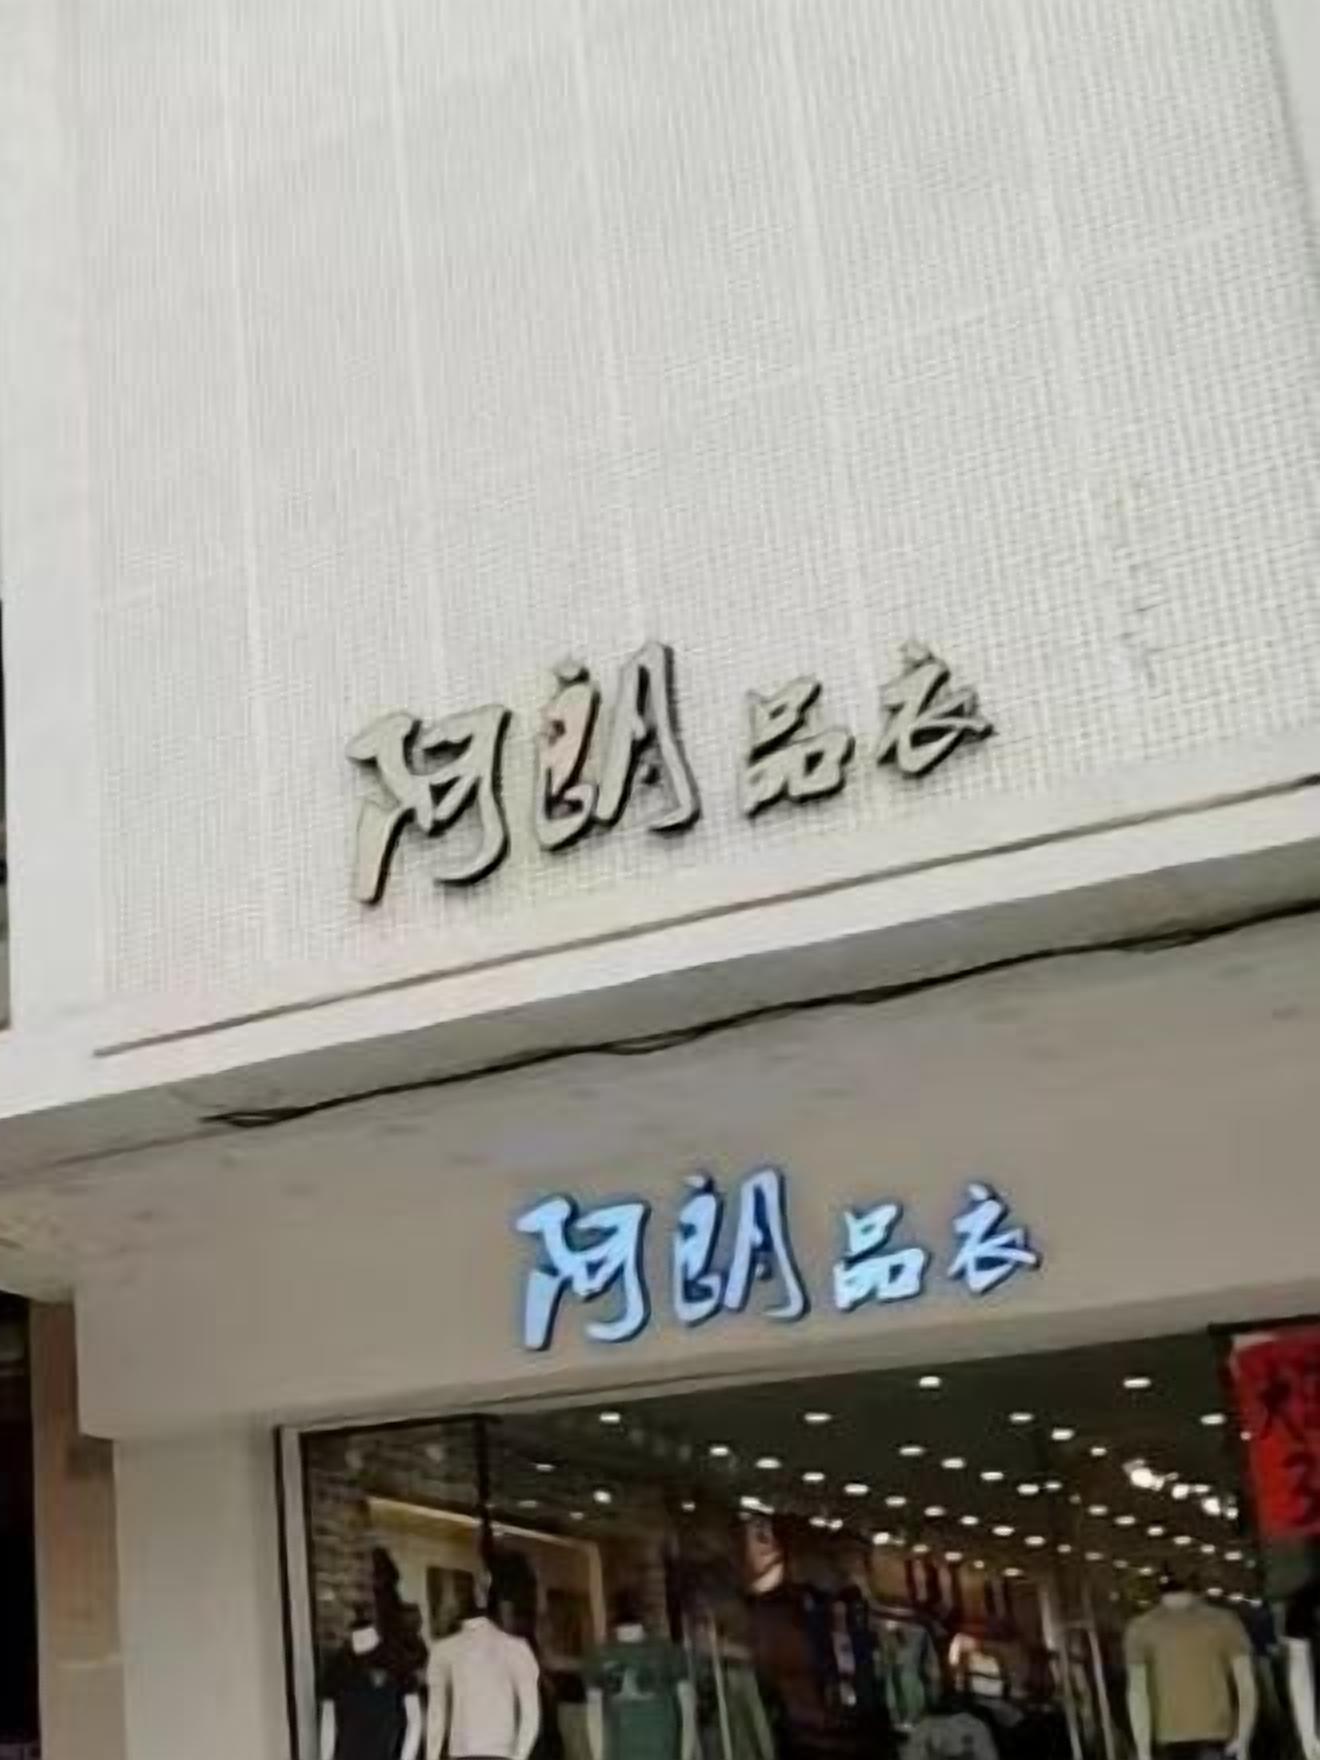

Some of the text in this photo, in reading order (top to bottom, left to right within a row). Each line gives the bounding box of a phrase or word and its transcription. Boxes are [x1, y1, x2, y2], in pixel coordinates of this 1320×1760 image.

[346, 641, 1000, 906] 阿朗品衣
[516, 1168, 1042, 1349] 阿朗品衣
